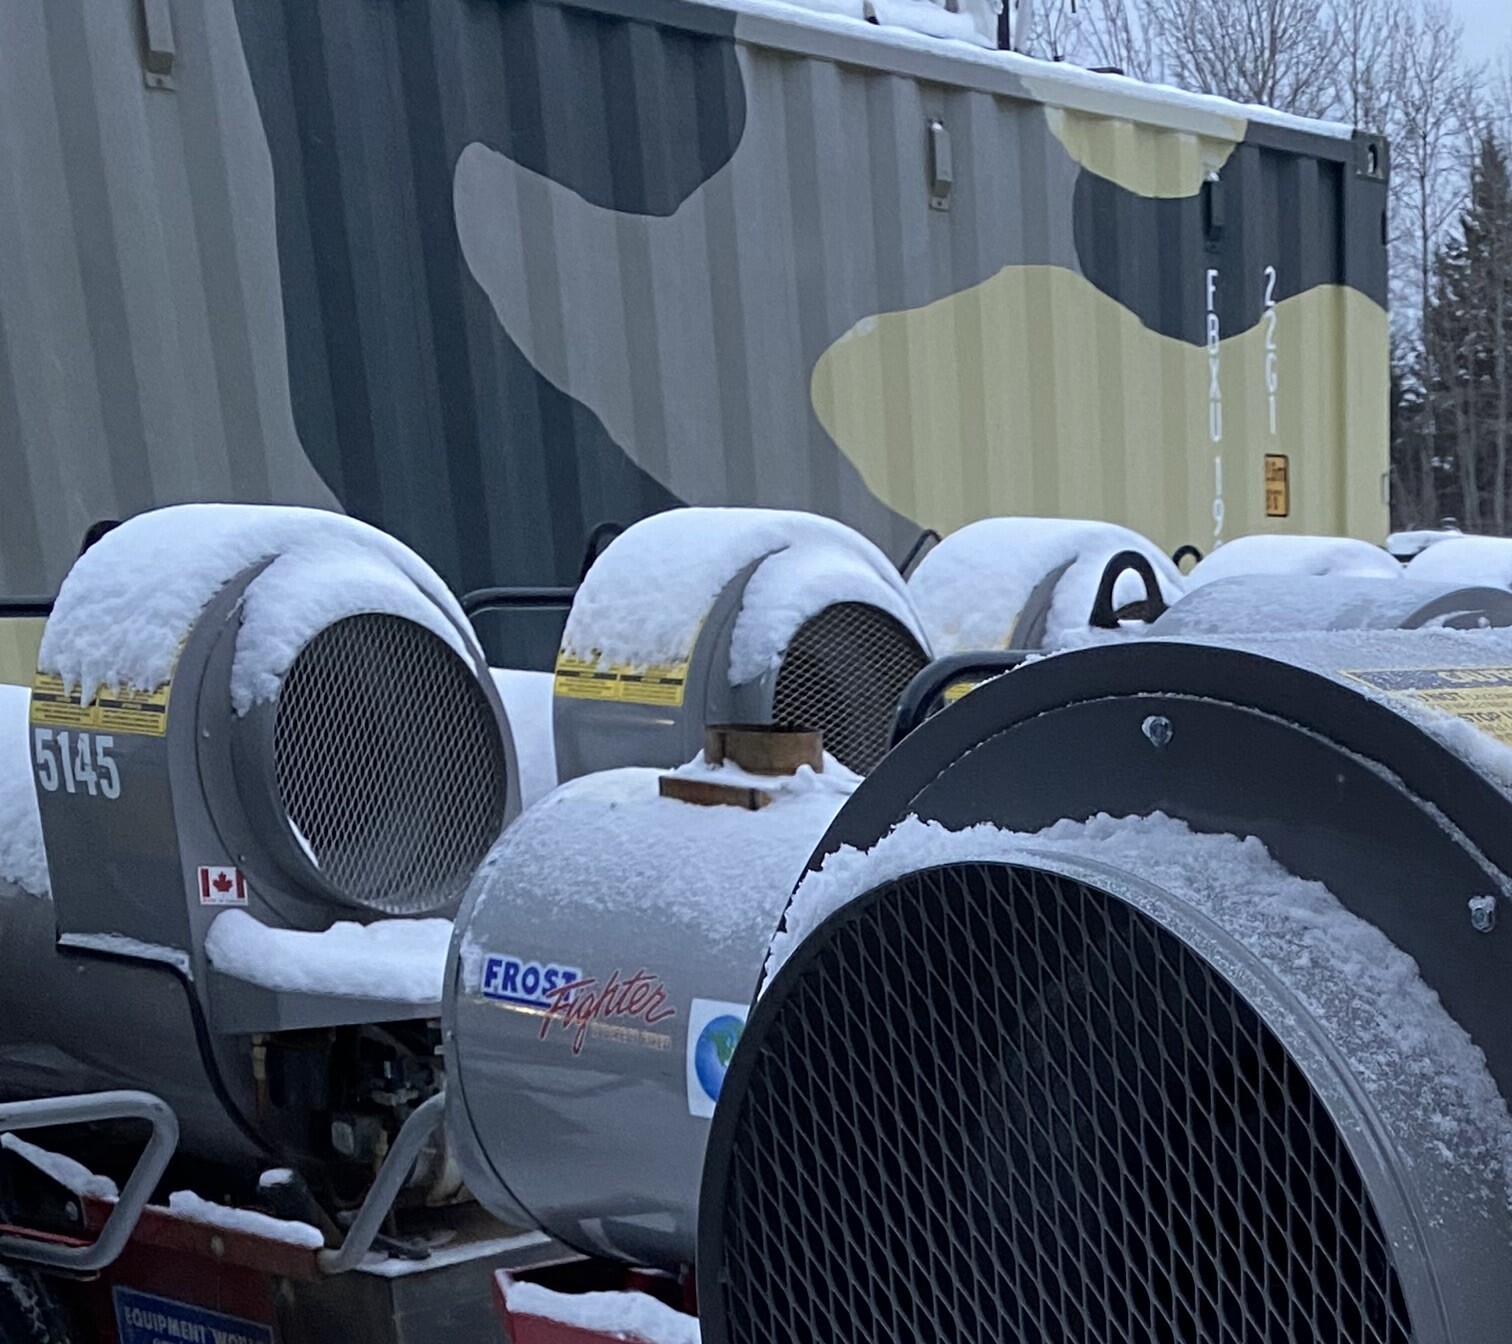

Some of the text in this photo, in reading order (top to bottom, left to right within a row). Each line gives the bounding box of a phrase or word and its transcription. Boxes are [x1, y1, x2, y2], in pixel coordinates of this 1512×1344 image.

[34, 728, 121, 800] 5145
[484, 958, 676, 1054] FROST Fighter
[125, 1306, 207, 1344] EQUIPMENT
